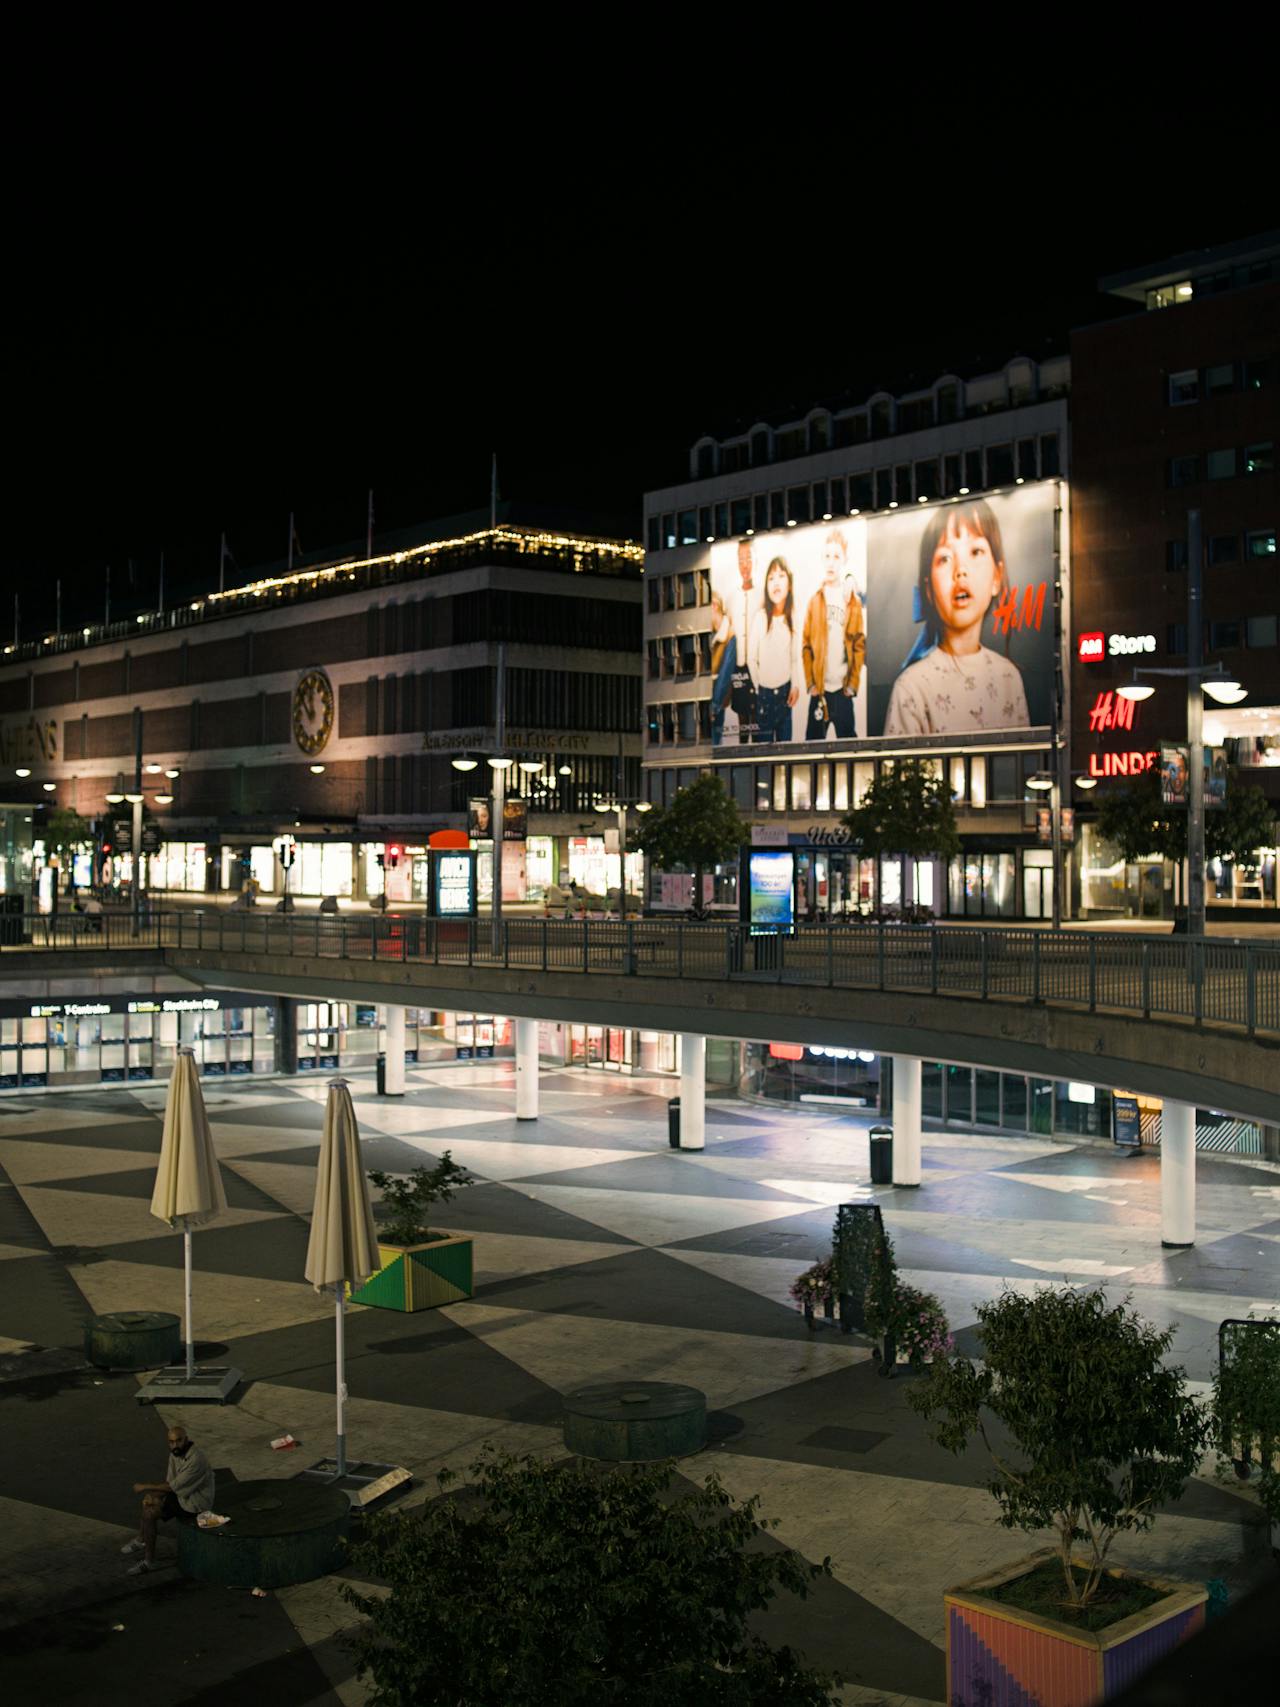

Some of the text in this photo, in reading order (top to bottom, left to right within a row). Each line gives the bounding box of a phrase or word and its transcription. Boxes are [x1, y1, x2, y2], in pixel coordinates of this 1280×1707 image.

[993, 582, 1047, 635] H&M
[1109, 634, 1156, 656] Store
[1089, 690, 1135, 732] H&M
[163, 1000, 203, 1011] Stockholm
[203, 999, 219, 1010] City
